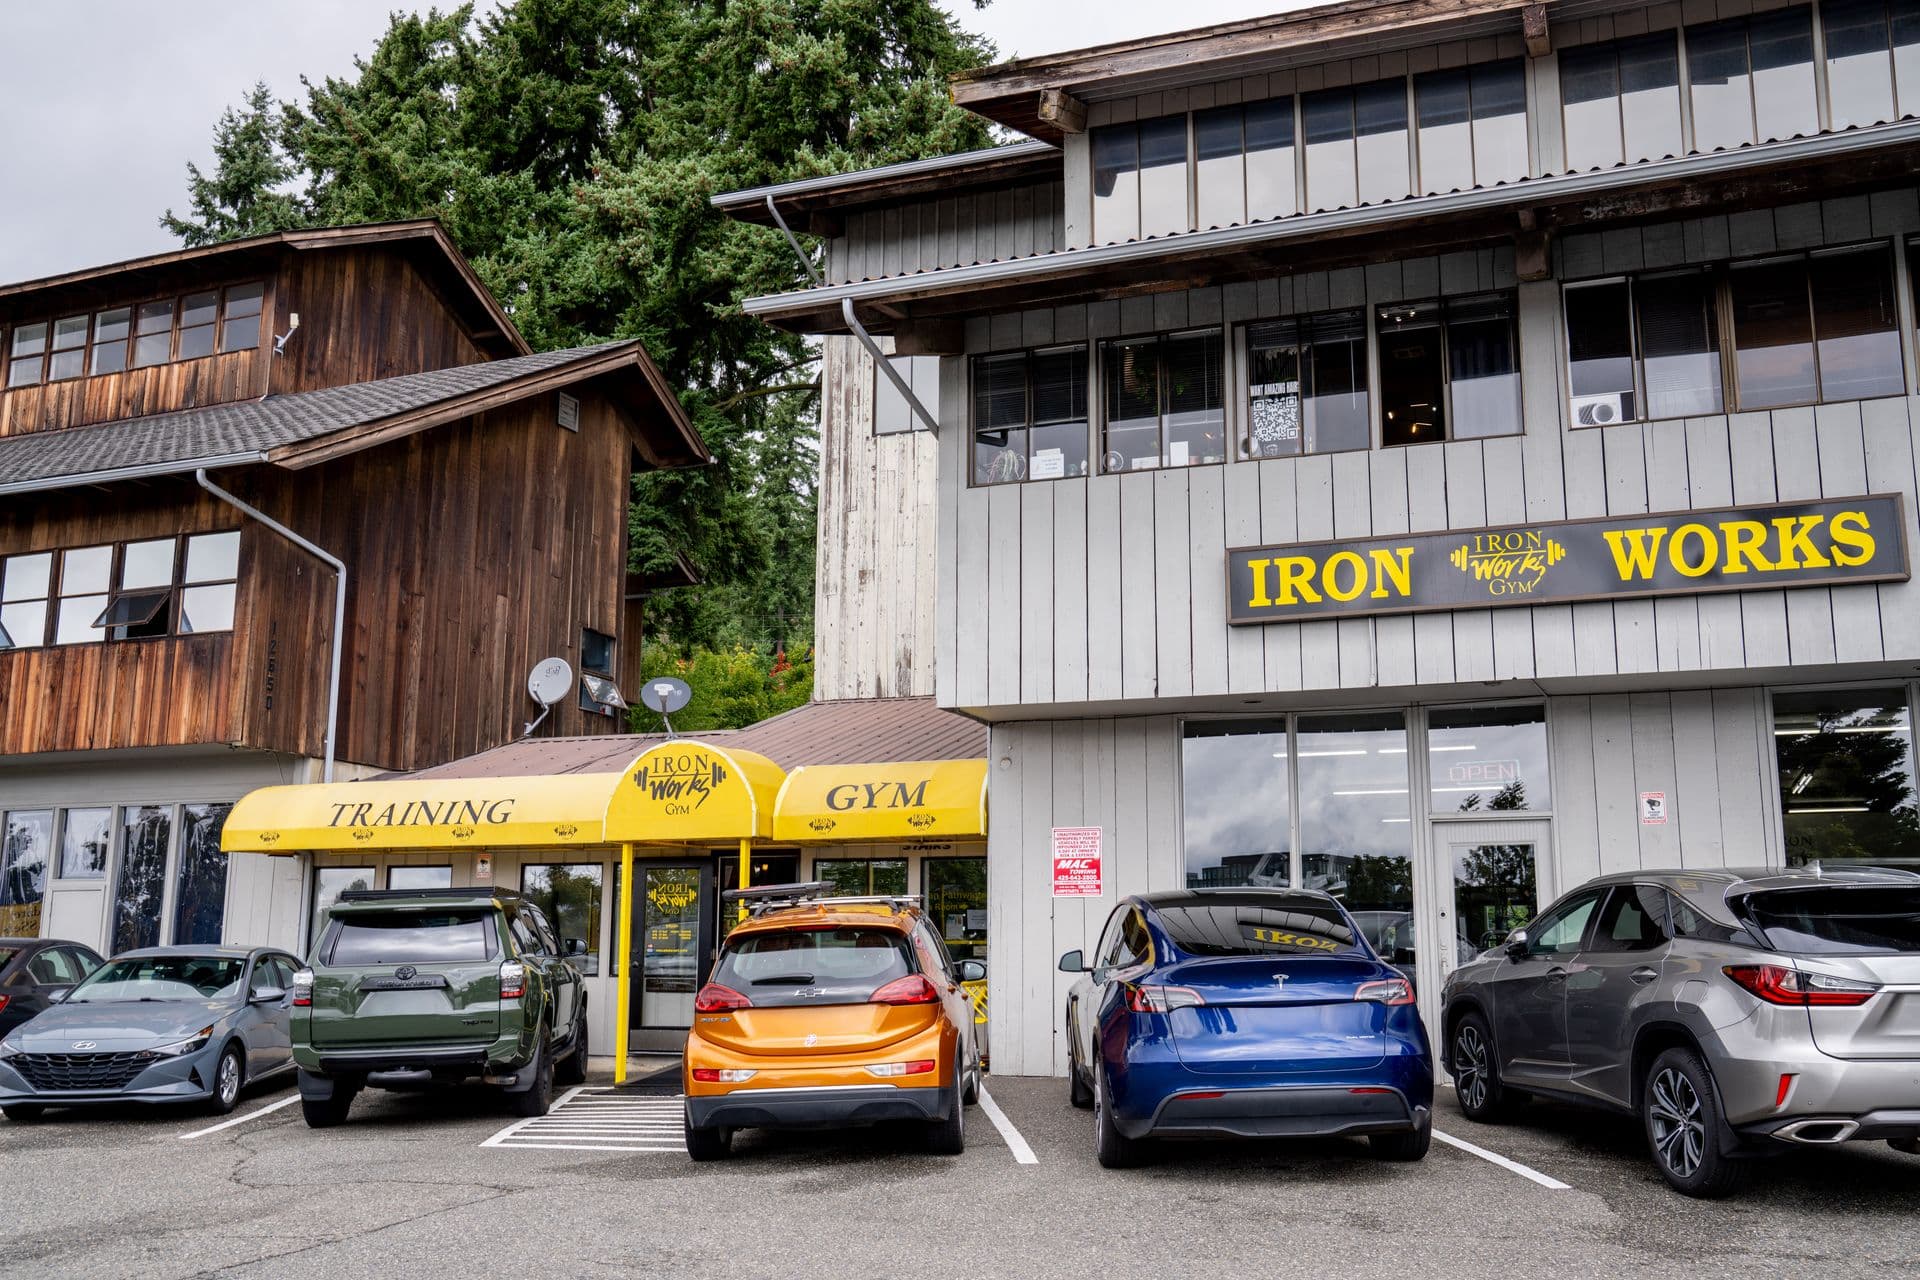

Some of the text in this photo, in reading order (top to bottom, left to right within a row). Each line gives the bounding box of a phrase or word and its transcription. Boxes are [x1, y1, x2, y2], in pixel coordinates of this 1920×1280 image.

[1474, 531, 1543, 553] IRON
[1247, 511, 1876, 608] IRON WORKS
[1470, 547, 1546, 587] Works
[653, 754, 709, 774] IRON
[1449, 763, 1515, 782] OPEN
[649, 769, 710, 810] Works
[826, 779, 930, 811] GYM
[327, 799, 515, 827] TRAINING
[1057, 859, 1093, 869] MAC
